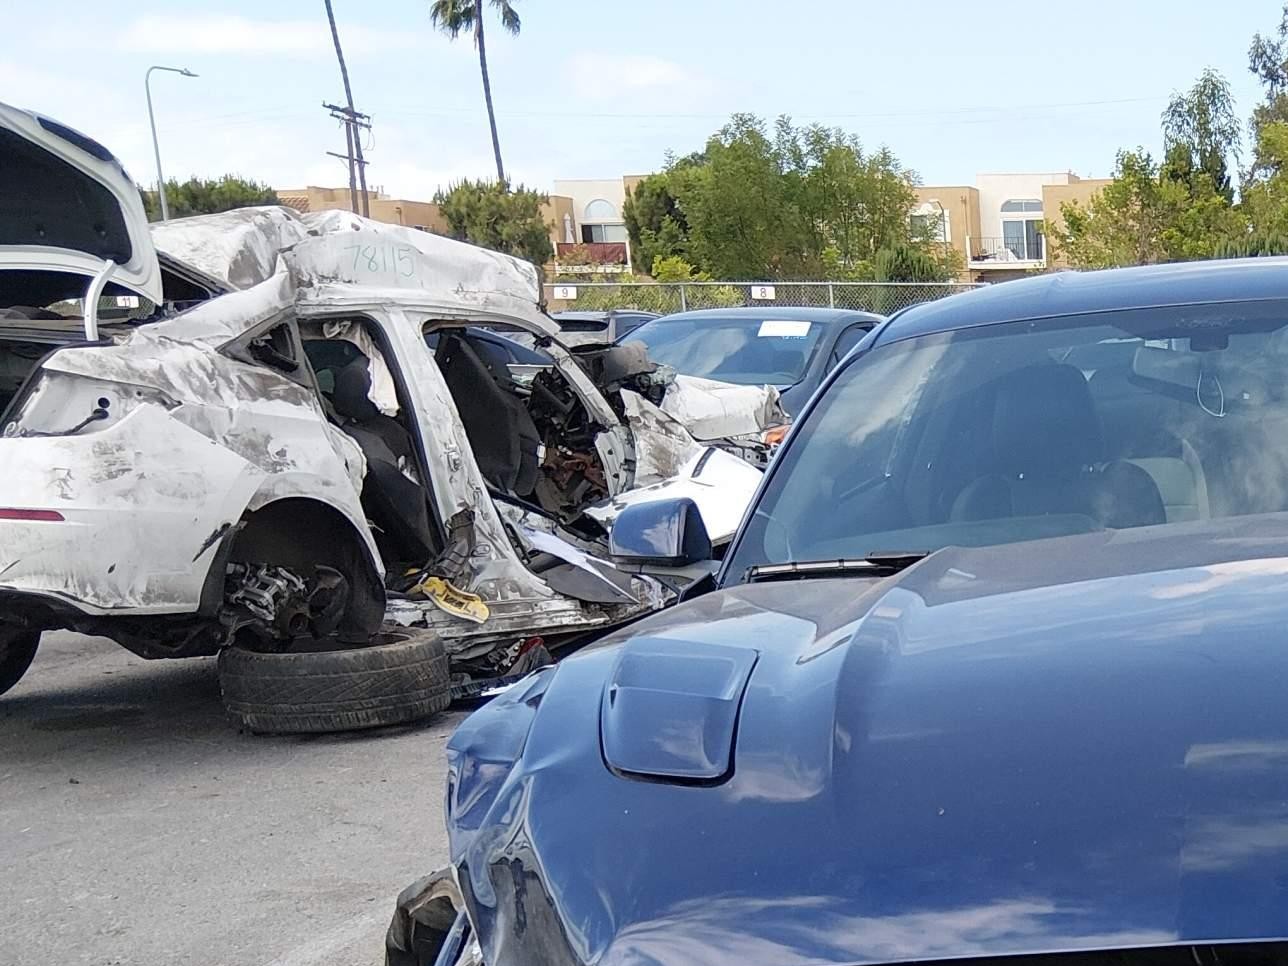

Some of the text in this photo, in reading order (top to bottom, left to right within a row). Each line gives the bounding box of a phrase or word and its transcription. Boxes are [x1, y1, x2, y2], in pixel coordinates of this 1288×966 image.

[343, 244, 415, 278] 78115
[561, 287, 569, 298] 9
[760, 287, 767, 298] 8
